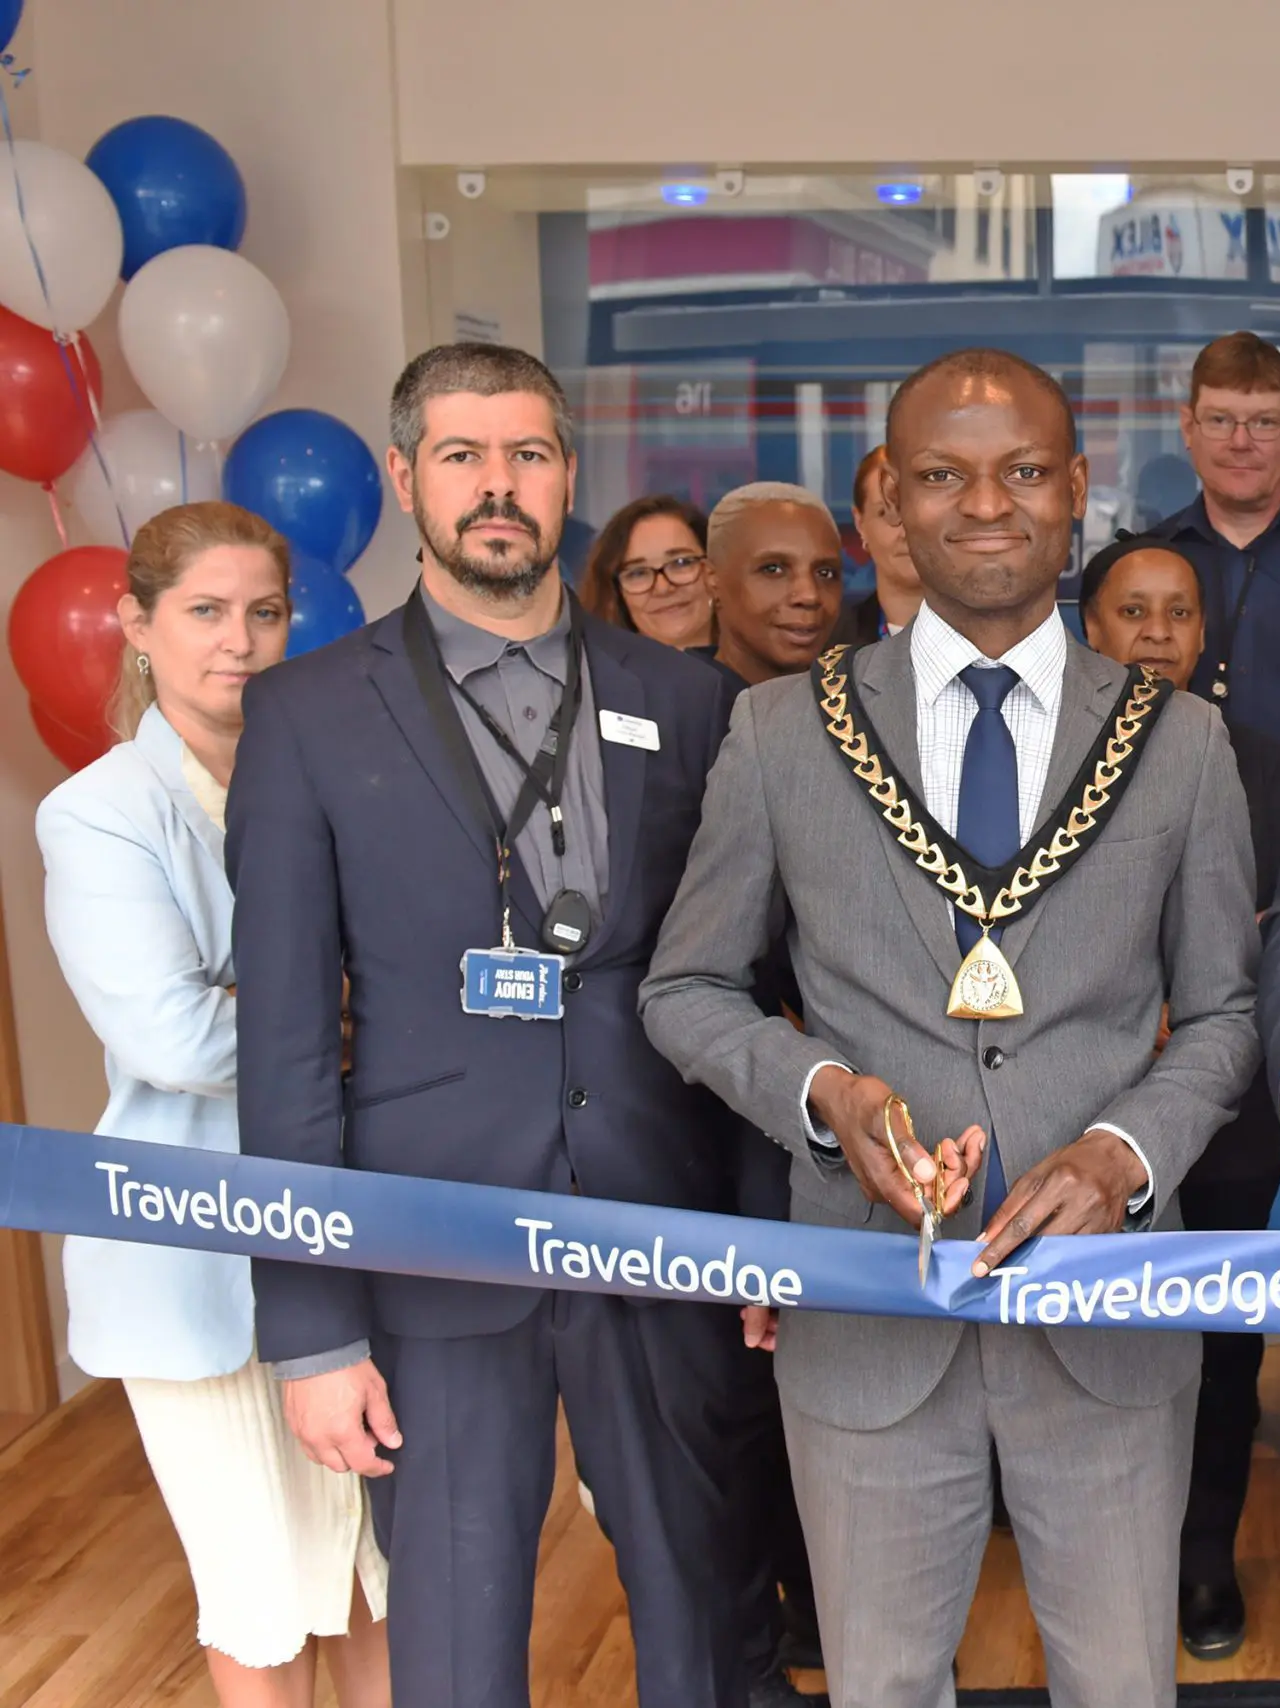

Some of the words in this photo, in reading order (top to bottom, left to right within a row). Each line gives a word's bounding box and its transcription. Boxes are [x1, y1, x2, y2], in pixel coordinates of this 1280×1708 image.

[495, 969, 513, 980] STAY
[515, 970, 534, 981] YOUR
[494, 981, 534, 1000] ENJOY
[95, 1161, 354, 1256] Travelodge
[514, 1217, 803, 1306] Travelodge
